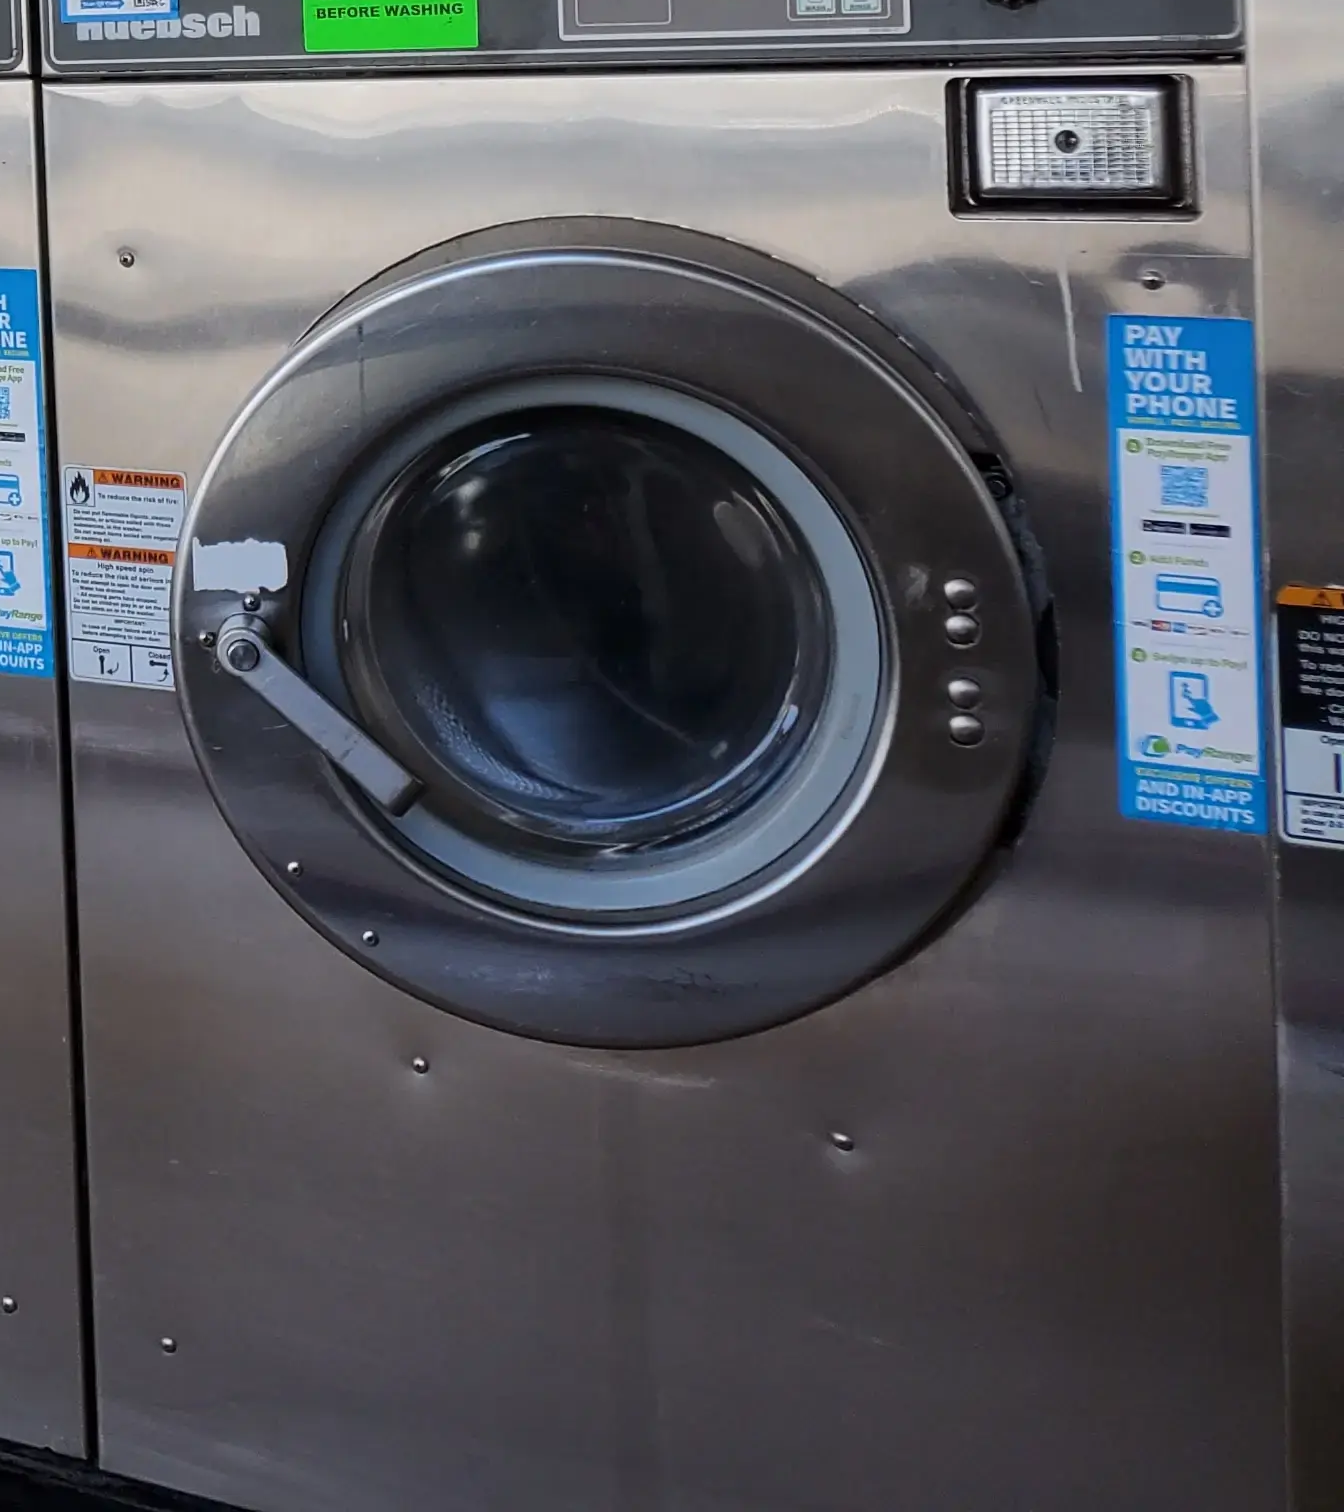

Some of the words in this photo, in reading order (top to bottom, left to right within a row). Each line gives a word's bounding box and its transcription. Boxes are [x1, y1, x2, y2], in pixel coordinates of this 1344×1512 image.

[316, 4, 382, 19] BEFORE
[384, 2, 464, 17] WASHING
[1123, 324, 1183, 347] PAY
[1123, 347, 1207, 371] WITH
[8, 366, 25, 374] Free
[8, 374, 22, 383] App
[1124, 370, 1213, 395] YOUR
[1126, 393, 1238, 419] PHONE
[111, 473, 180, 489] WARNING
[107, 493, 130, 501] reduce
[143, 495, 156, 503] risk
[1, 538, 12, 546] up
[12, 537, 20, 545] to
[100, 547, 169, 564] WARNING
[98, 562, 113, 571] High
[116, 565, 136, 573] speed
[139, 565, 154, 574] spin
[139, 576, 163, 584] serious
[1298, 631, 1320, 641] DO
[0, 640, 43, 654] IN-APP
[93, 645, 110, 654] Open
[1299, 642, 1319, 653] this
[1299, 659, 1316, 670] To
[1175, 743, 1254, 763] PayRange
[1137, 779, 1179, 797] AND
[1182, 785, 1253, 805] IN-APP
[1136, 796, 1255, 825] DISCOUNTS
